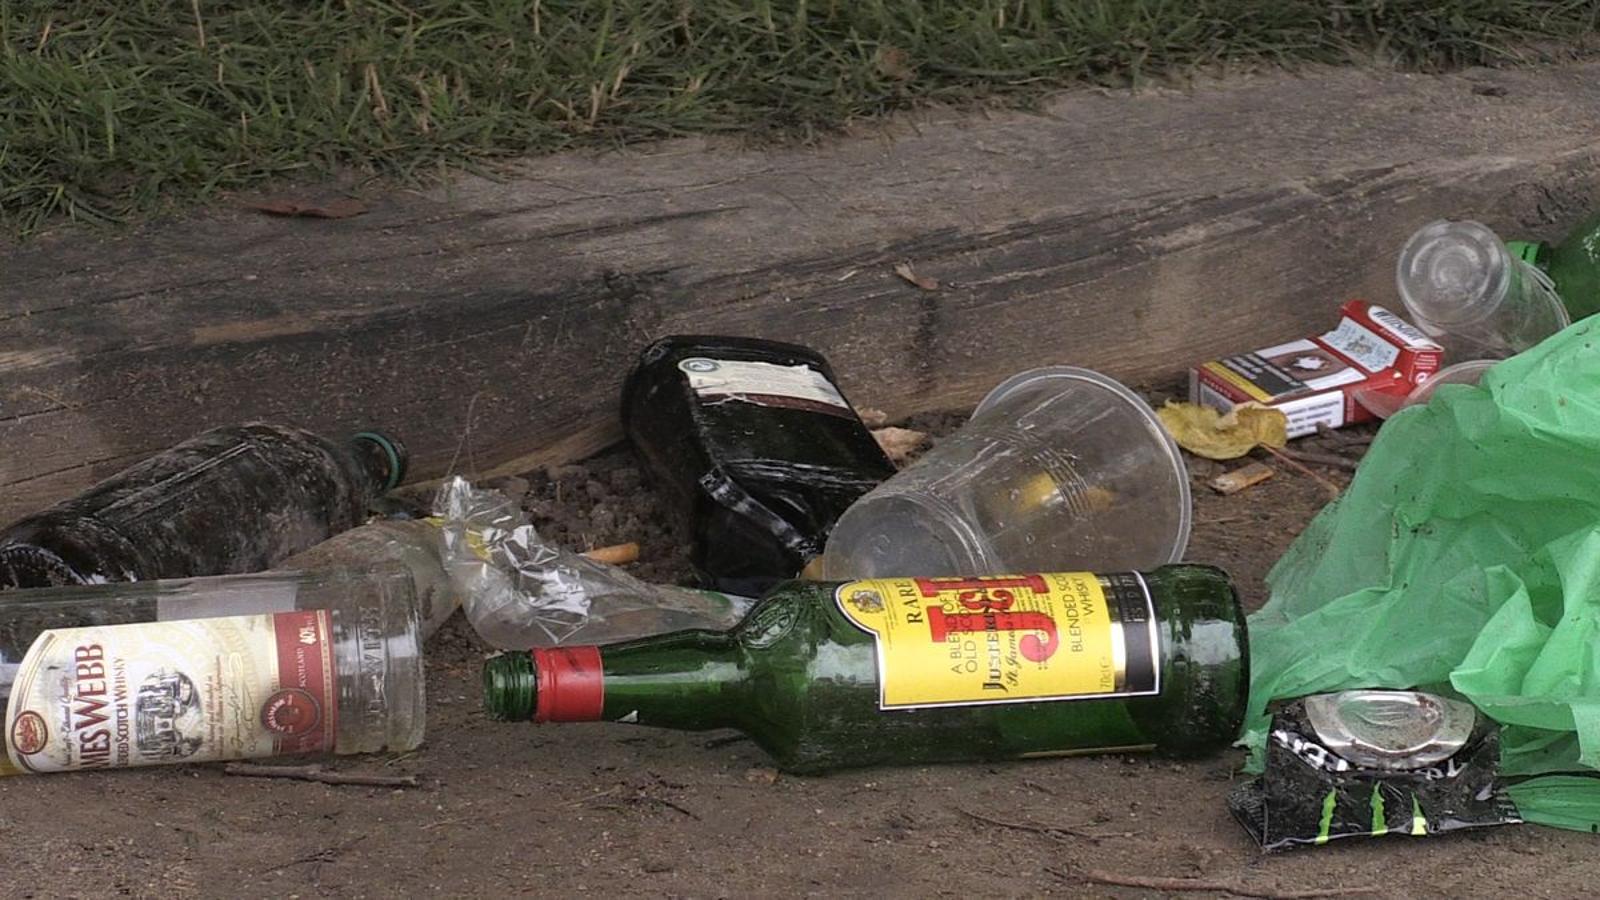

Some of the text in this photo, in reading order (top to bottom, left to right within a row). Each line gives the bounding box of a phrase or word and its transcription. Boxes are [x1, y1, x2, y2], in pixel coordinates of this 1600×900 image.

[895, 580, 924, 624] RARE
[1071, 576, 1095, 617] WHISKY
[1062, 593, 1084, 653] BLENDED
[951, 663, 963, 675] A
[962, 640, 978, 673] OLD
[73, 643, 110, 732] WEBB
[113, 657, 128, 703] WHISKY
[114, 703, 129, 742] SCOTCH
